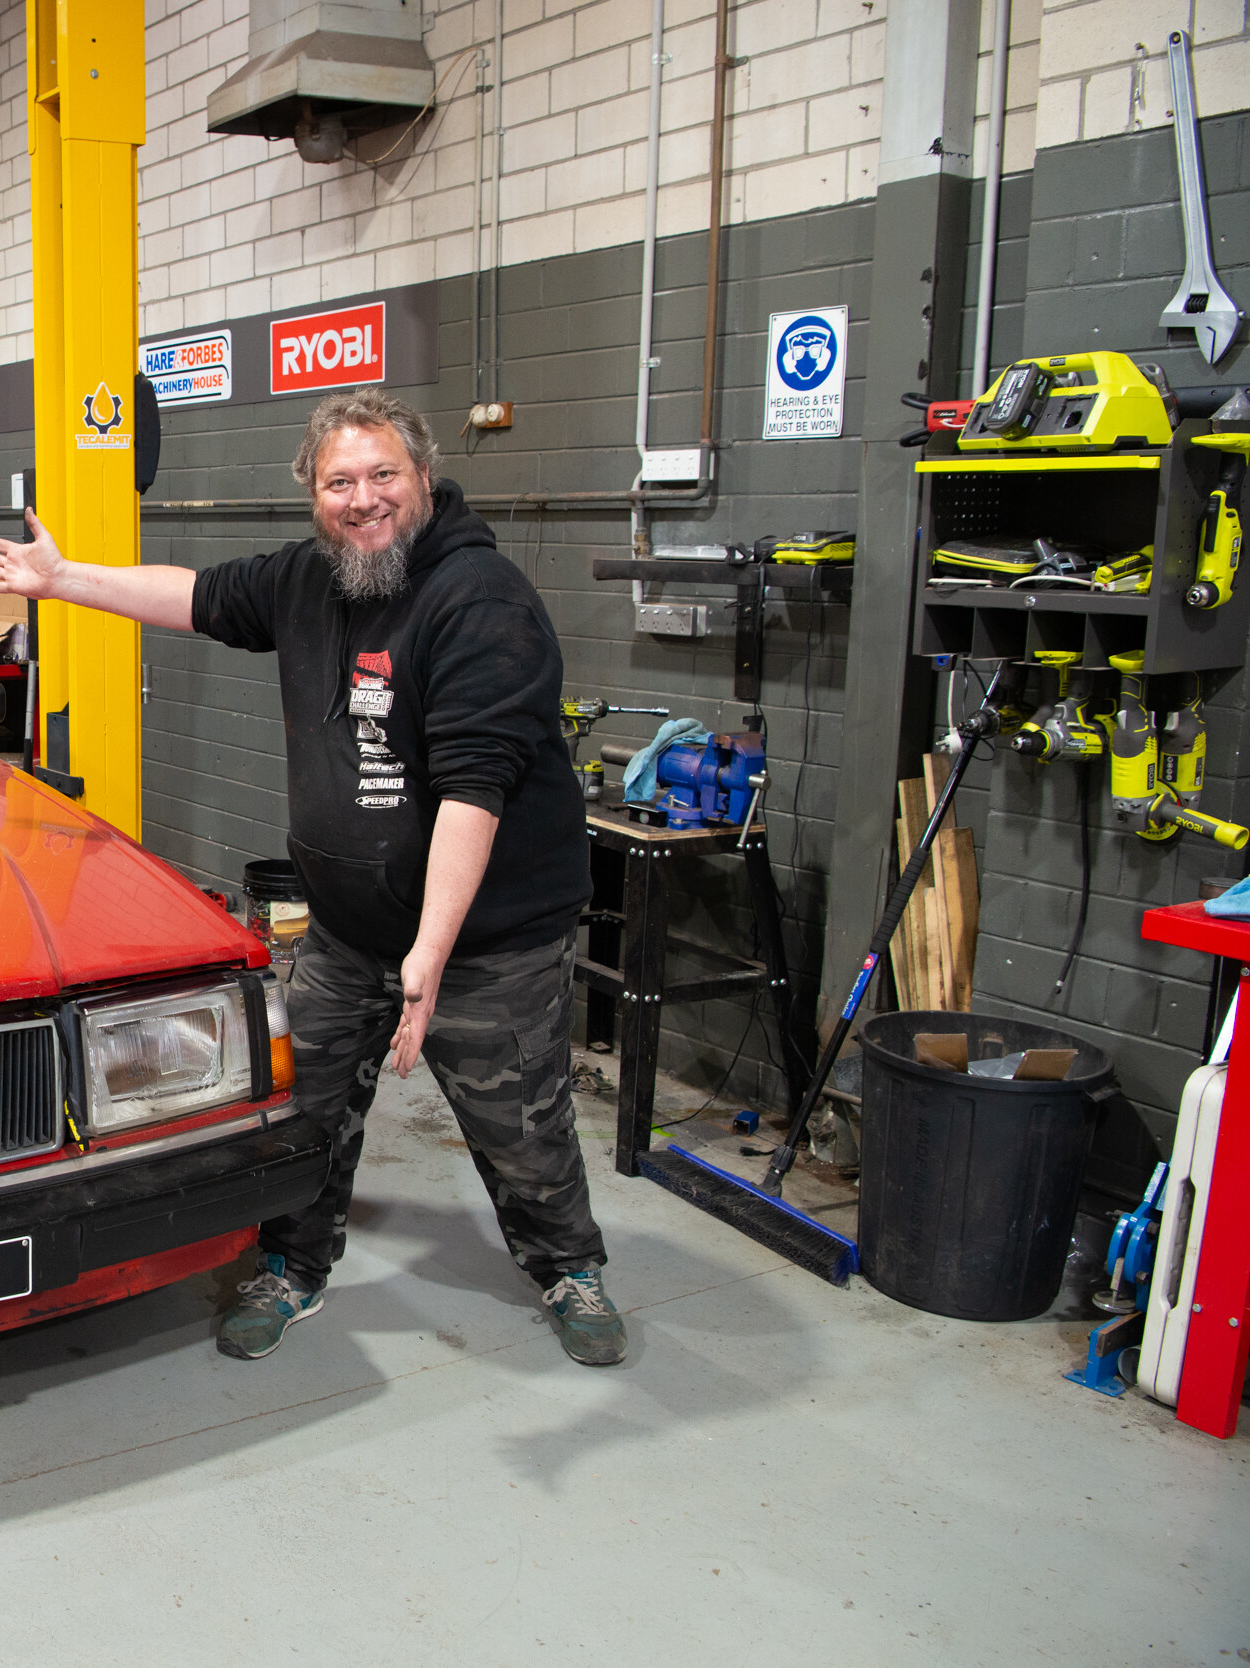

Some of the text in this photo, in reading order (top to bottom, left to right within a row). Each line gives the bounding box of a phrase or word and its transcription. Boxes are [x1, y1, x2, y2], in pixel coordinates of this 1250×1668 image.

[280, 324, 372, 376] RYOBI
[770, 394, 840, 408] HEARING & EYE
[775, 408, 833, 420] PROTECTION
[769, 420, 839, 432] MUST BE WORN
[77, 435, 130, 444] TECALEMIT
[350, 690, 383, 704] DRAG
[359, 762, 405, 771] Haltech
[358, 777, 405, 790] PACEMAKER
[1175, 816, 1204, 833] RYOBI
